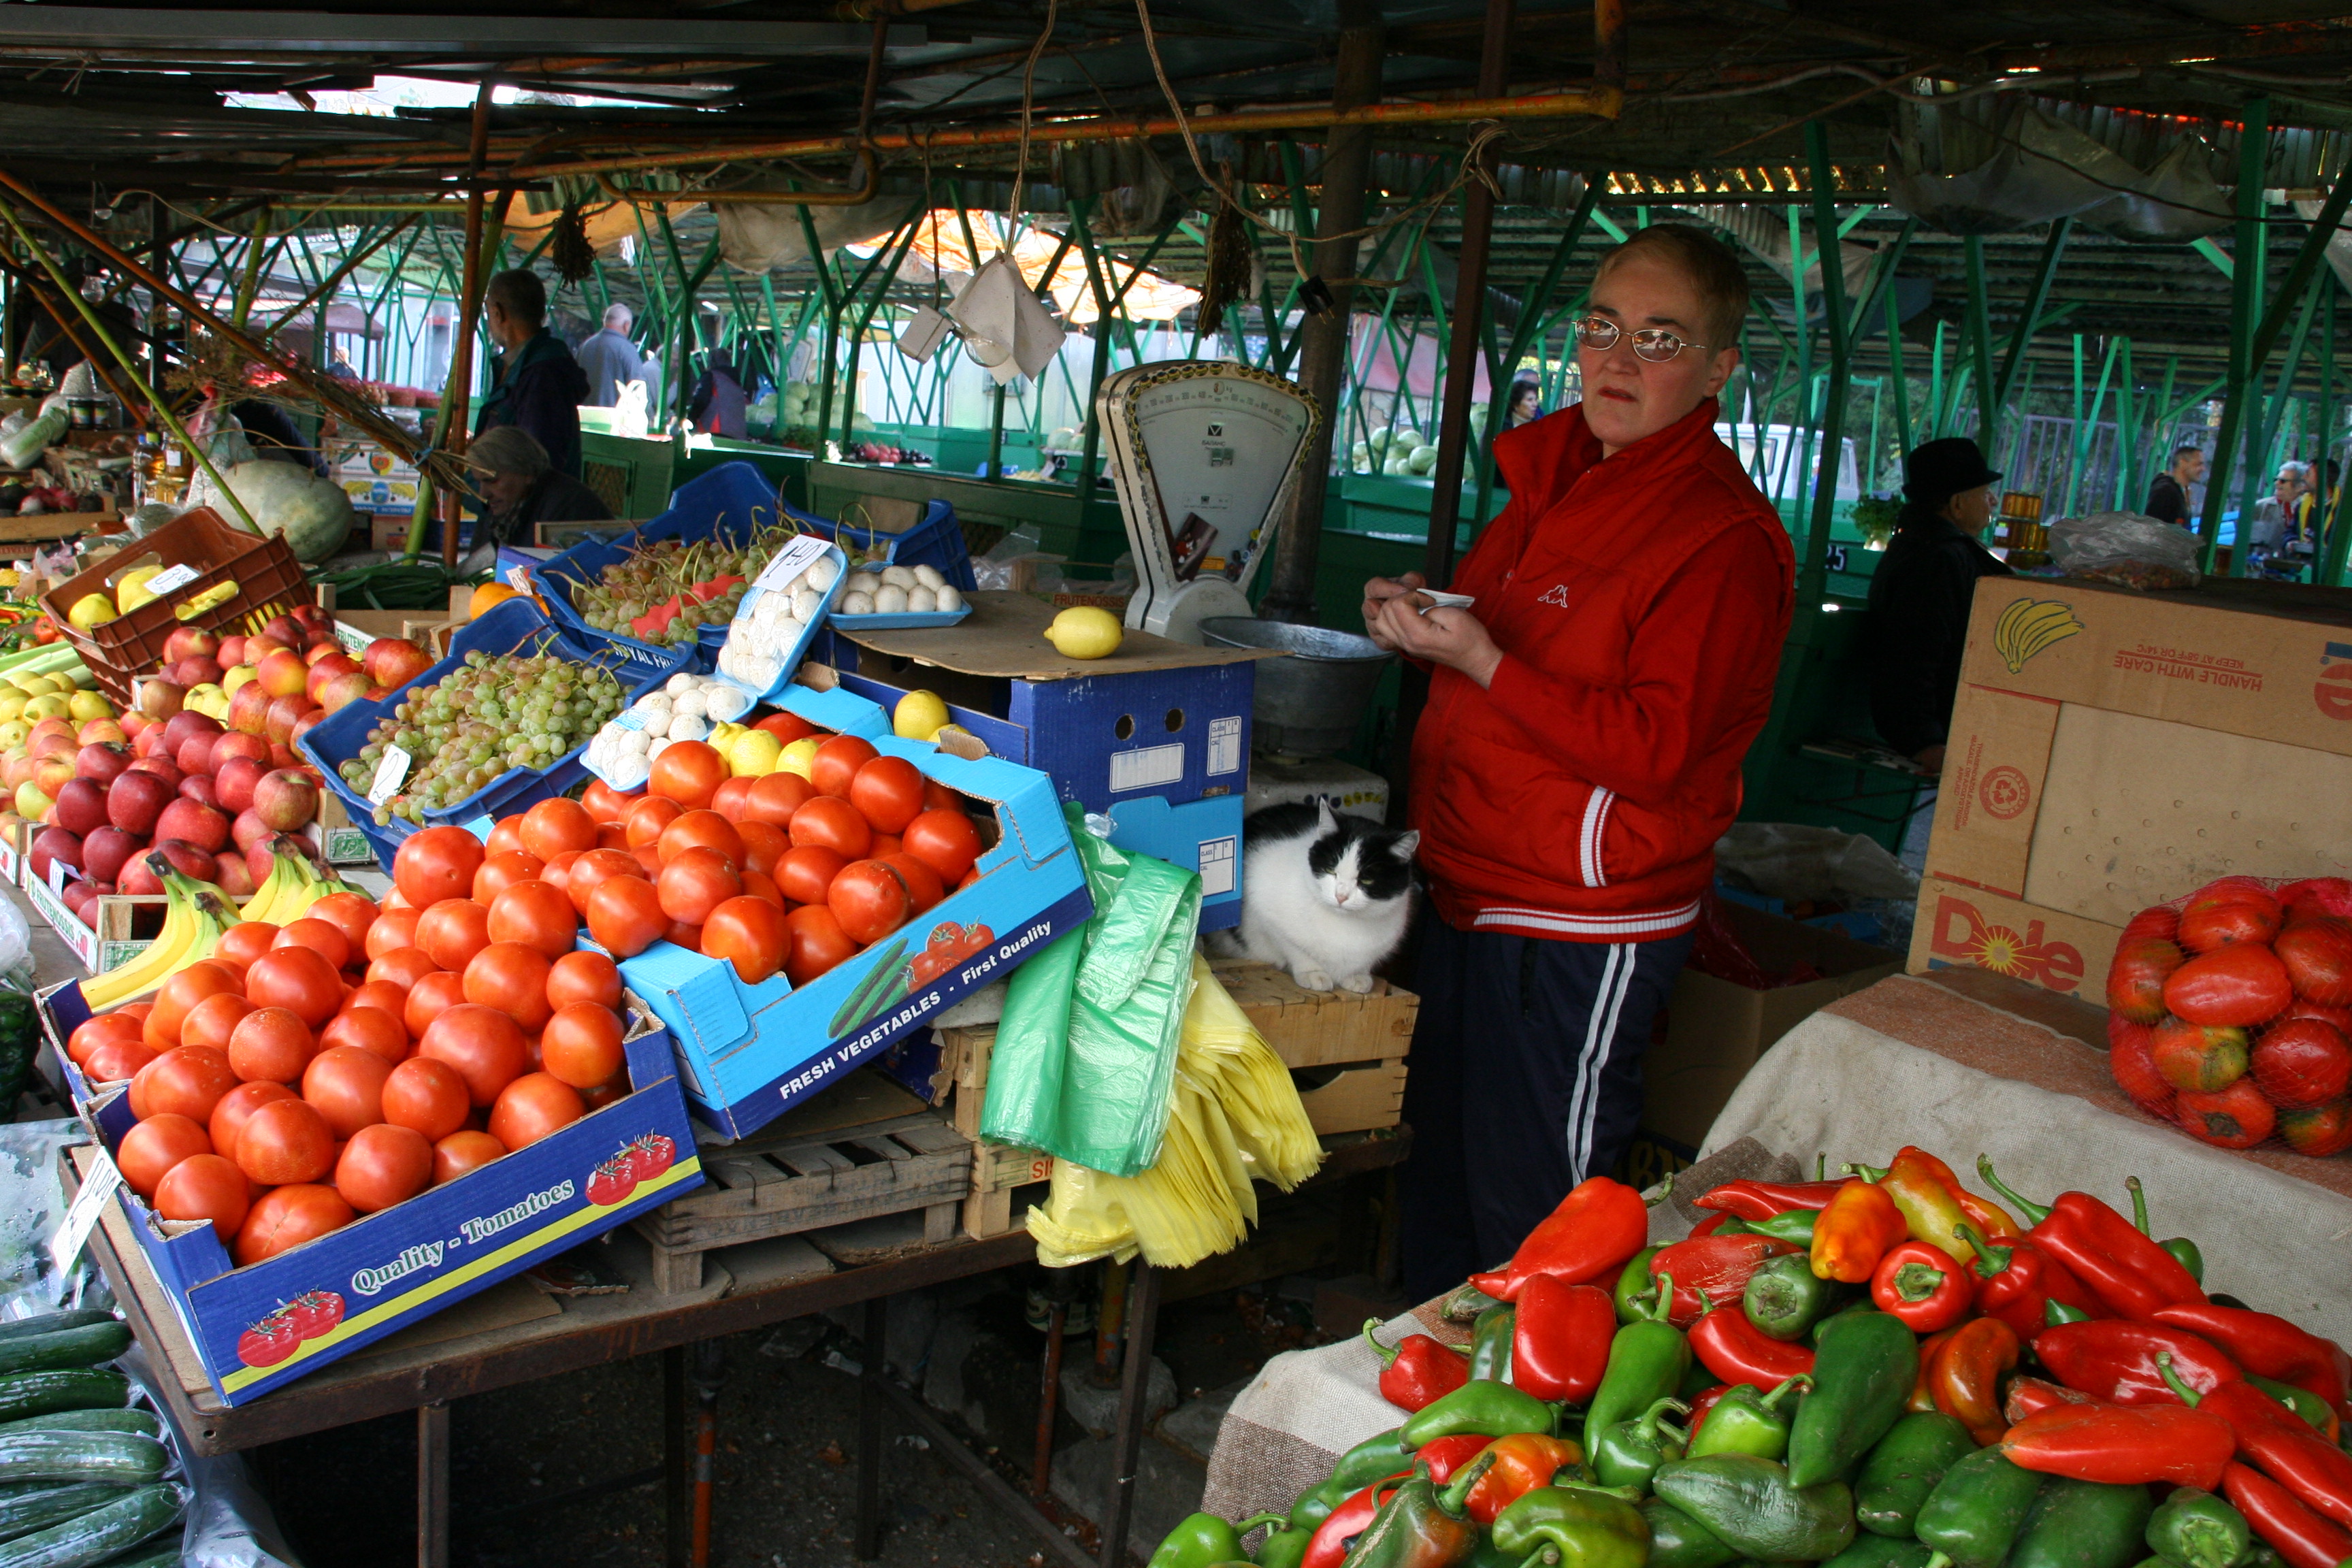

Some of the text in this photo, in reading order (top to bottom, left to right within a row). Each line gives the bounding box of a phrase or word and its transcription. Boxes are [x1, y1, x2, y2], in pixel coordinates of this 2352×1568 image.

[1054, 593, 1124, 608] FRUTENOSSIS
[2160, 647, 2176, 658] OR
[2200, 654, 2214, 665] AT
[2215, 657, 2244, 670] KEEP
[2113, 655, 2263, 692] HANDLE WITH CARE
[1930, 894, 2085, 992] Dole
[779, 1057, 836, 1100] FRESH
[838, 990, 941, 1062] VEGETABLES
[961, 956, 998, 985] First
[999, 921, 1051, 960] Quality
[352, 1240, 445, 1294] Quality
[461, 1179, 575, 1245] Tomatoes
